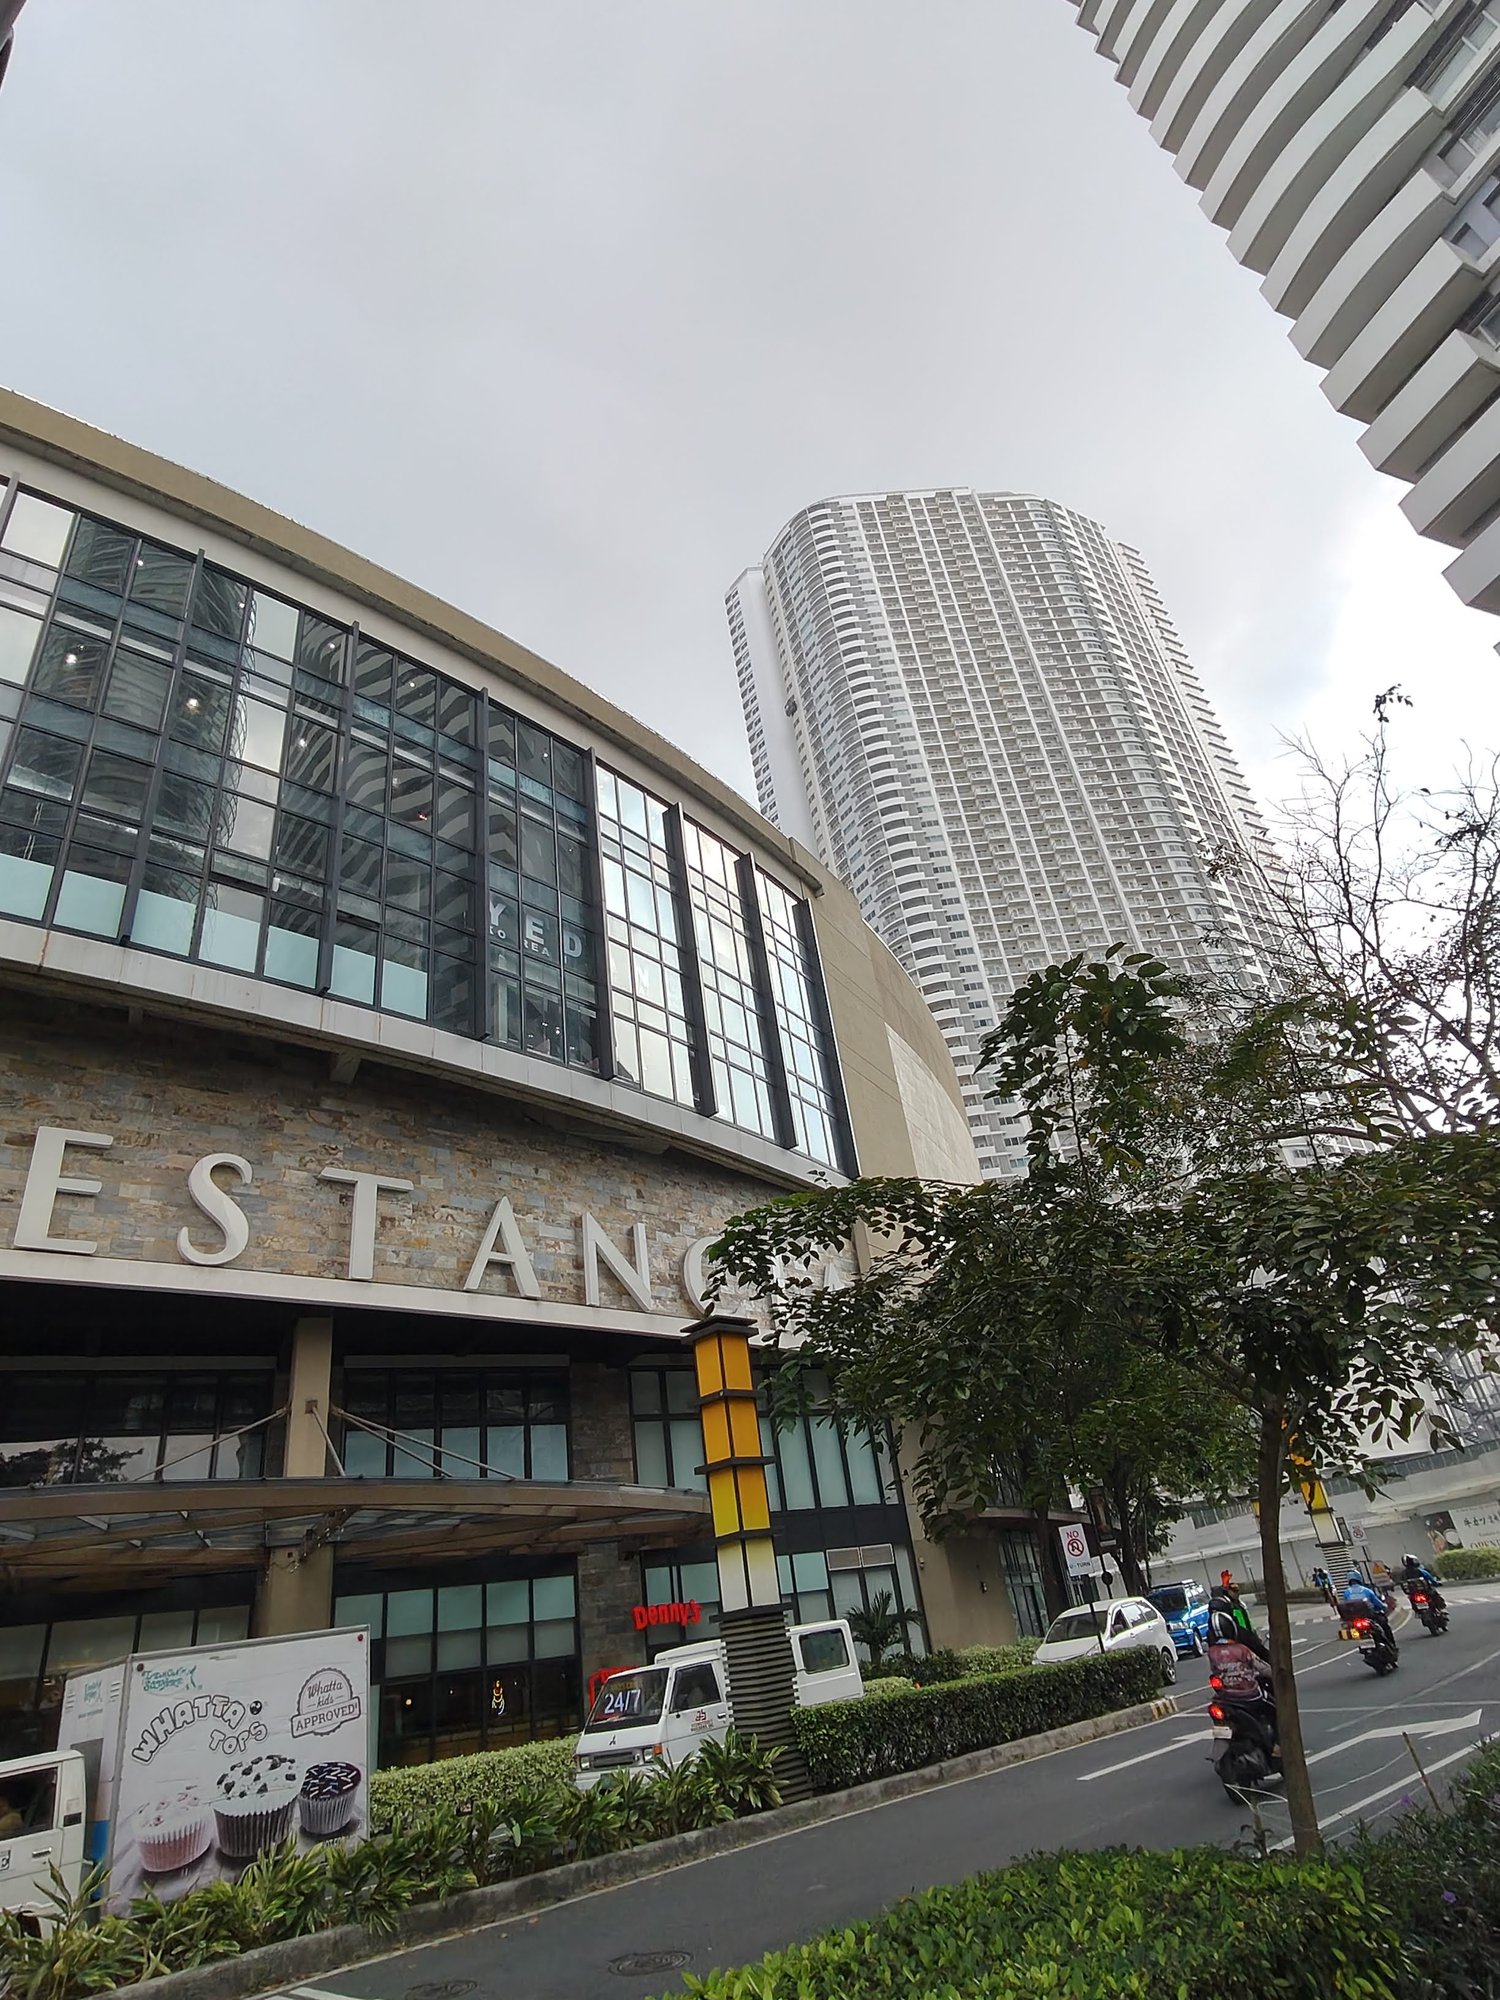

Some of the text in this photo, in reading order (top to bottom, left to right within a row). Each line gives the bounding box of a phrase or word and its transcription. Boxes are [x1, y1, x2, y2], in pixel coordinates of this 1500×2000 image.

[1065, 1530, 1079, 1539] NO
[632, 1599, 702, 1632] Denny's
[308, 1680, 343, 1699] Whatta
[316, 1693, 335, 1708] kids
[131, 1694, 246, 1763] WHATTA
[209, 1721, 268, 1755] TOPS
